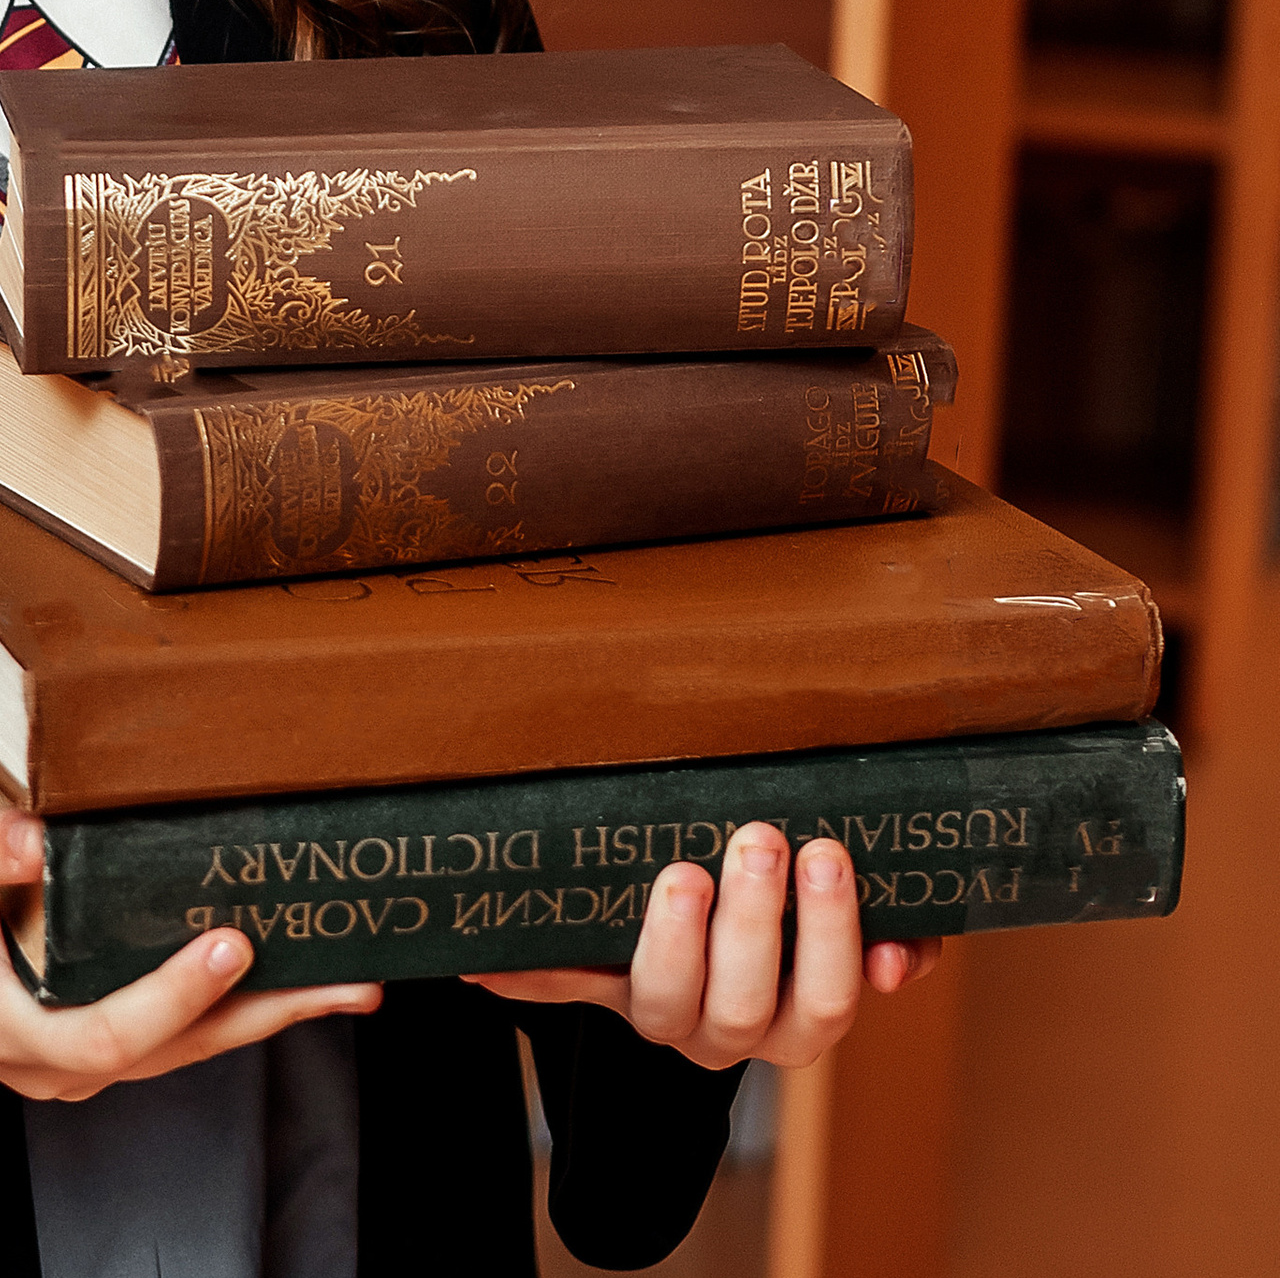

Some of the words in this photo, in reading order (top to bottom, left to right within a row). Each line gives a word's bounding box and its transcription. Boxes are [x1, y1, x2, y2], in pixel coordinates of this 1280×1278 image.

[741, 168, 772, 264] ROTA
[364, 235, 404, 287] 21
[784, 219, 820, 333] TJEPOLO
[485, 449, 518, 506] 22
[201, 829, 542, 887] DICTIONARY
